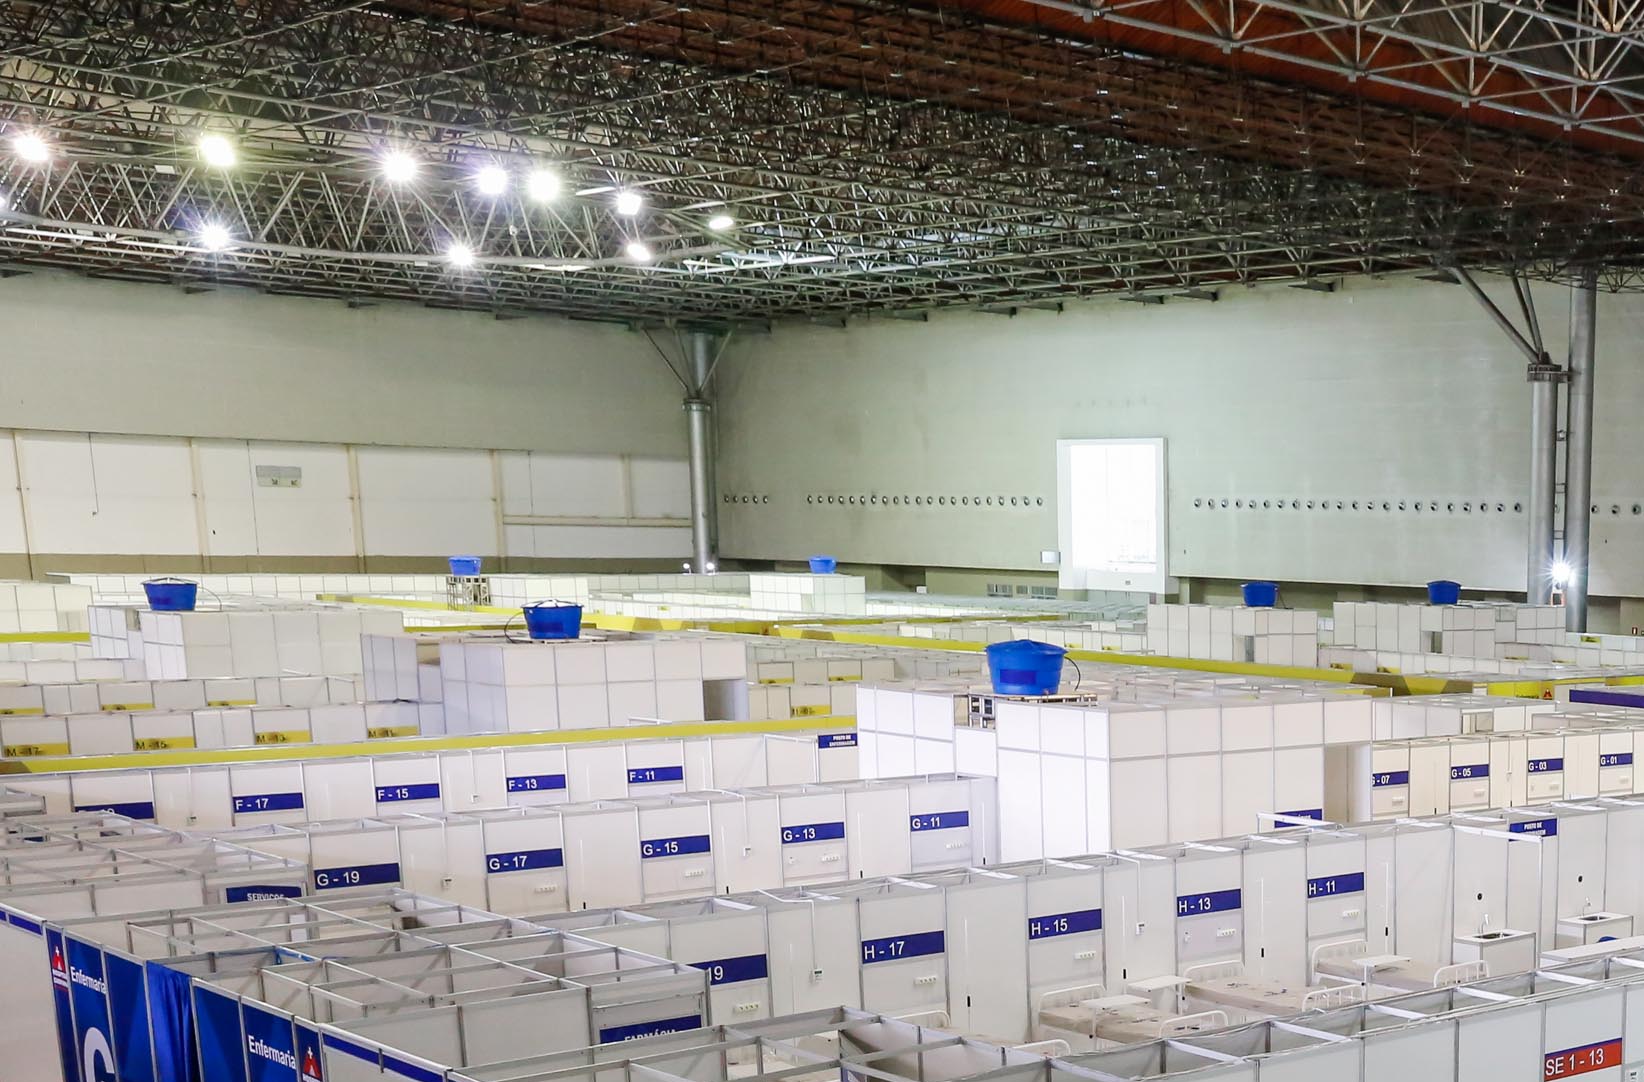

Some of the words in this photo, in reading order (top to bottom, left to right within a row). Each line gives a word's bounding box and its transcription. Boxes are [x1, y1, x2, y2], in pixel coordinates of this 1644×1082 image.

[1600, 756, 1606, 765] G
[1610, 756, 1618, 765] 01
[629, 771, 636, 782] F
[645, 770, 655, 780] 11
[1451, 768, 1458, 778] G
[1462, 767, 1471, 777] 05
[508, 780, 515, 790] F
[525, 779, 537, 789] 13
[377, 789, 385, 800] F
[396, 788, 409, 799] 15
[235, 799, 243, 810] F
[255, 798, 269, 809] 17
[912, 818, 921, 829] G
[930, 816, 940, 827] 11
[783, 830, 793, 841] G
[803, 828, 816, 839] 13
[643, 844, 653, 856] G
[664, 841, 678, 853] 15
[489, 858, 500, 870] G
[512, 855, 527, 868] 17
[317, 873, 329, 886] G
[343, 871, 360, 884] 19
[1308, 883, 1317, 896] H
[1325, 880, 1336, 893] 11
[1179, 900, 1188, 913] H
[1198, 897, 1211, 911] 13
[1031, 922, 1041, 936] H
[1053, 918, 1068, 932] 15
[864, 945, 875, 960] H
[889, 941, 905, 956] 17
[70, 966, 107, 995] Enfermaria
[248, 1034, 296, 1070] Enfermaria
[1545, 1056, 1565, 1076] SE
[1569, 1054, 1575, 1071] 1
[1589, 1048, 1604, 1066] 13
